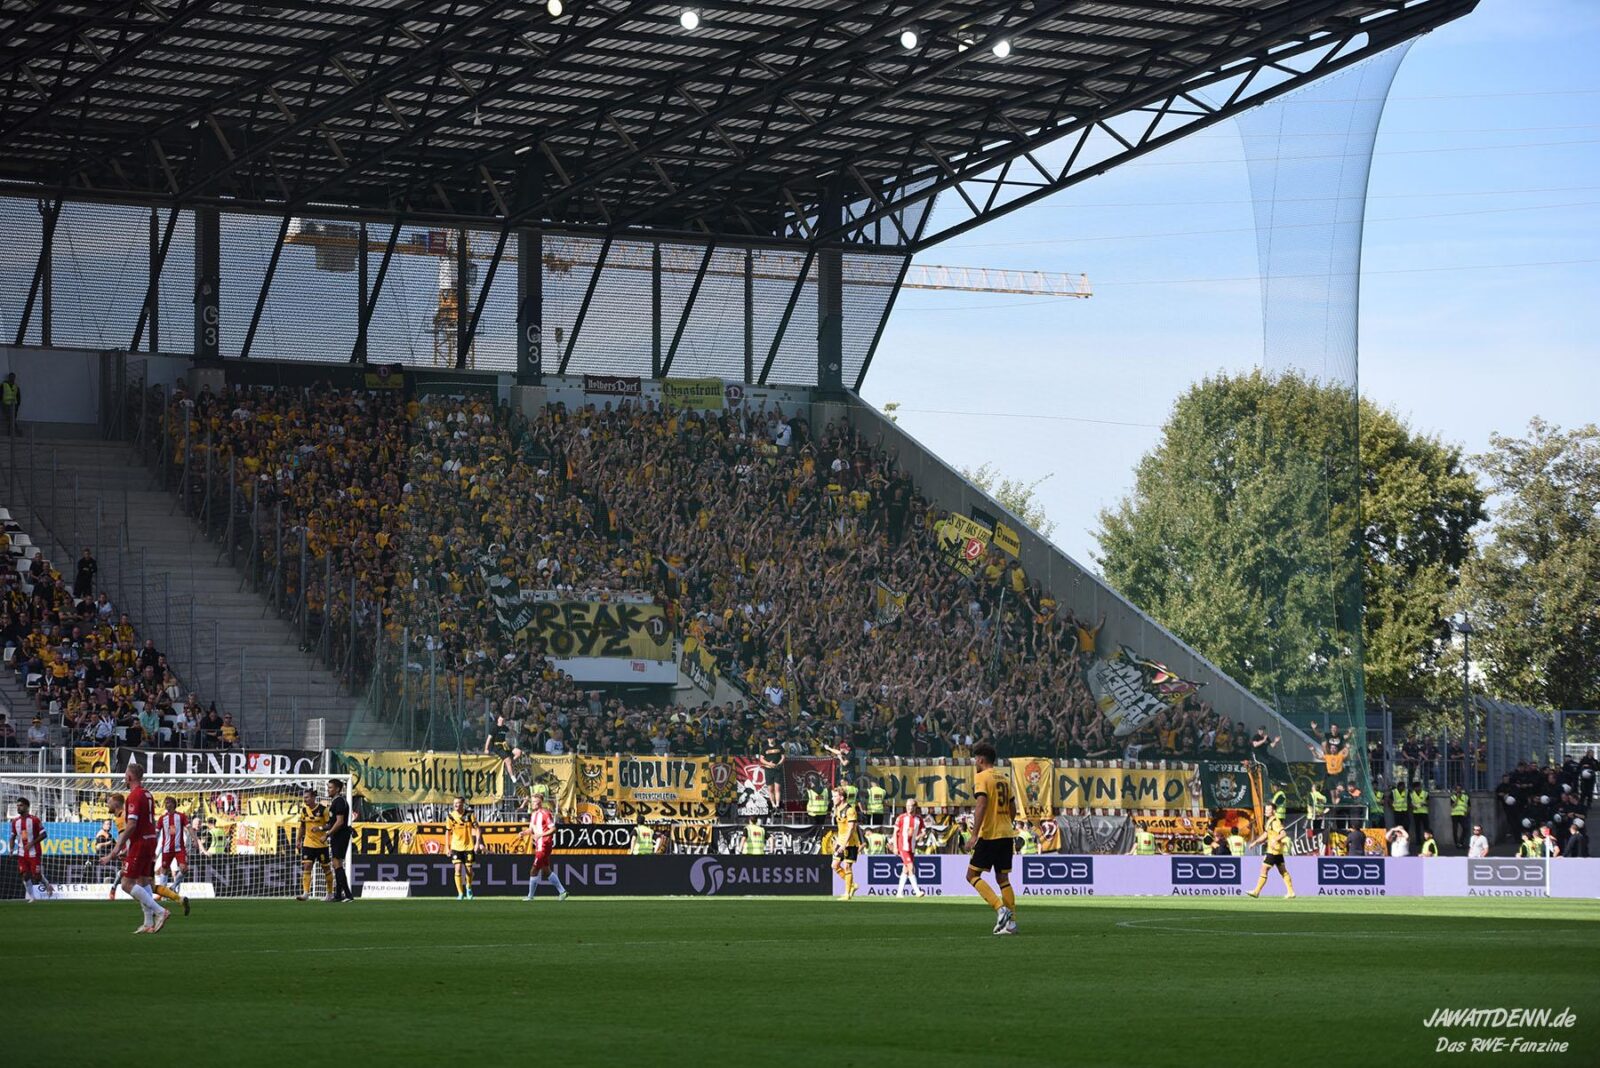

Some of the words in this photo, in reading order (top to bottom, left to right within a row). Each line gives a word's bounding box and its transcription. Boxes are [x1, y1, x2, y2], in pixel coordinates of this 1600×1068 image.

[618, 755, 697, 789] GÖRLITZ
[1059, 775, 1184, 802] DYNAMO
[726, 866, 820, 884] SALESSEN
[1027, 862, 1089, 879] BOB
[1176, 863, 1236, 879] BOB
[1322, 863, 1380, 880] BOB
[1473, 865, 1544, 881] BOB
[1022, 887, 1094, 896] Automobile
[1172, 887, 1242, 896] Automobile
[1318, 887, 1386, 896] Automobile
[1468, 888, 1549, 897] Automobile
